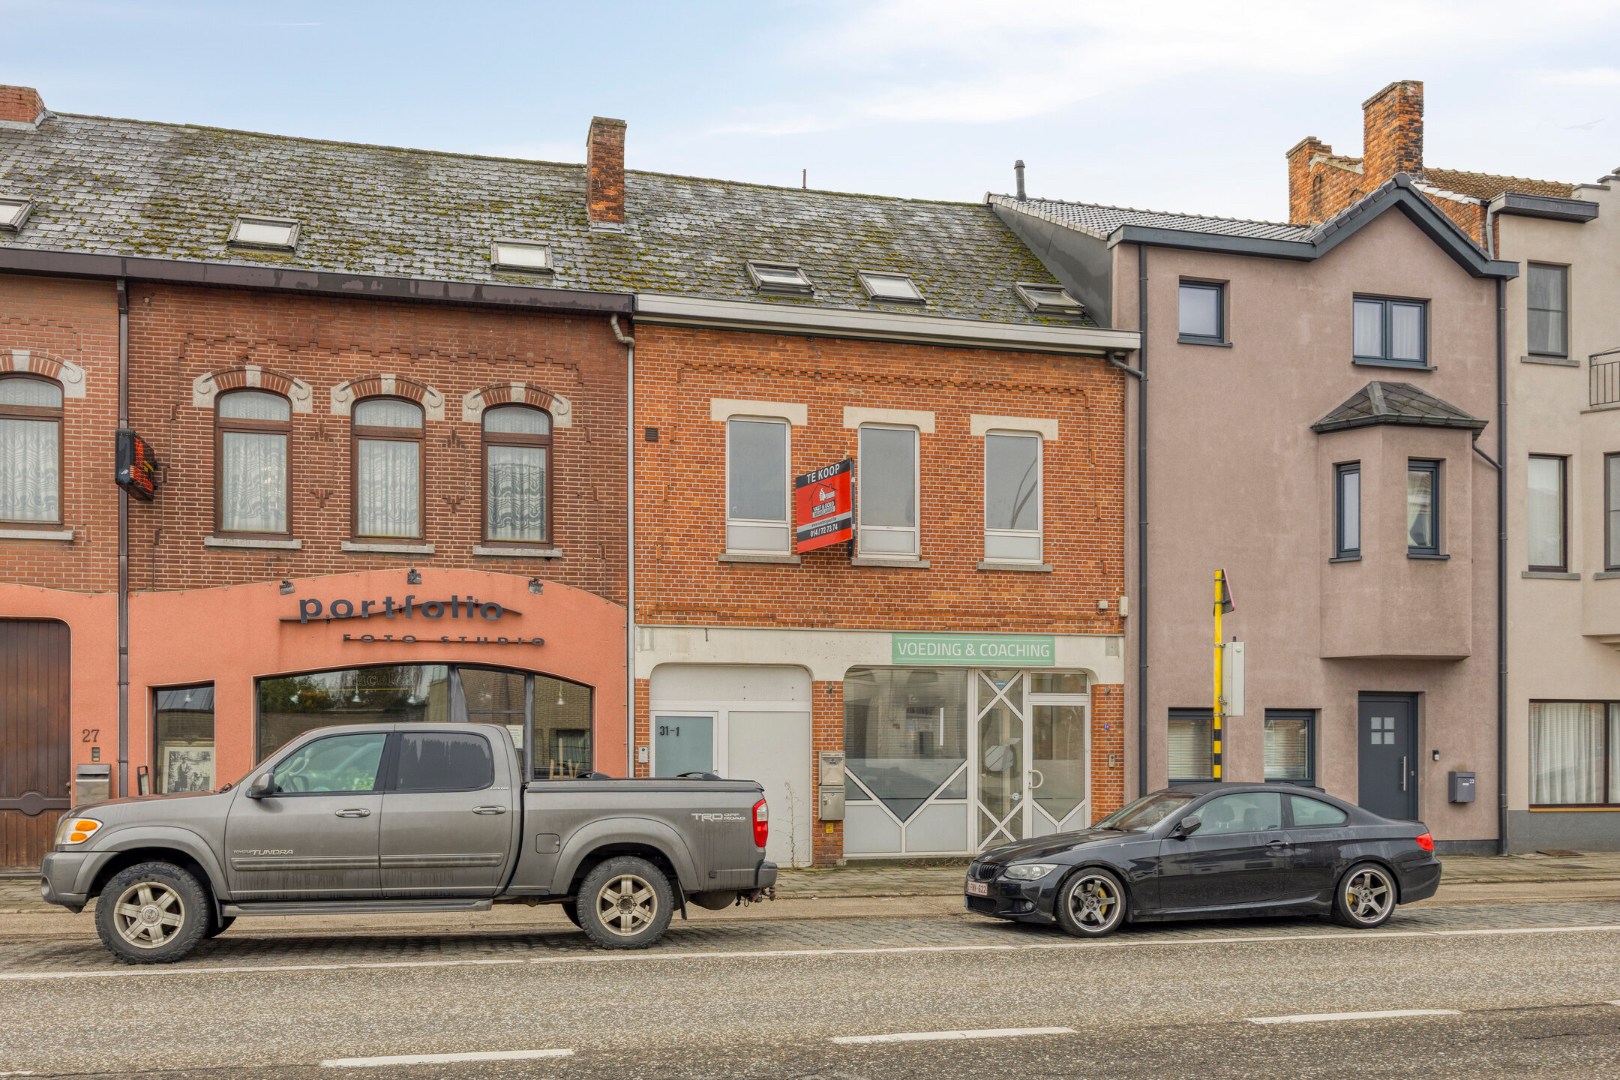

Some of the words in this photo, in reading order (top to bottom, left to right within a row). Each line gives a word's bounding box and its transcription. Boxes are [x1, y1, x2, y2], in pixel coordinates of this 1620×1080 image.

[807, 472, 816, 484] TE
[818, 463, 840, 480] KOOP
[300, 594, 505, 624] portfolio
[343, 633, 417, 643] FOTO
[440, 636, 545, 646] STUDIO
[898, 642, 961, 656] VOEDING
[965, 643, 976, 656] &
[980, 643, 1050, 657] COACHING
[82, 728, 100, 743] 27
[660, 725, 680, 737] 31-1
[691, 813, 723, 822] TRD
